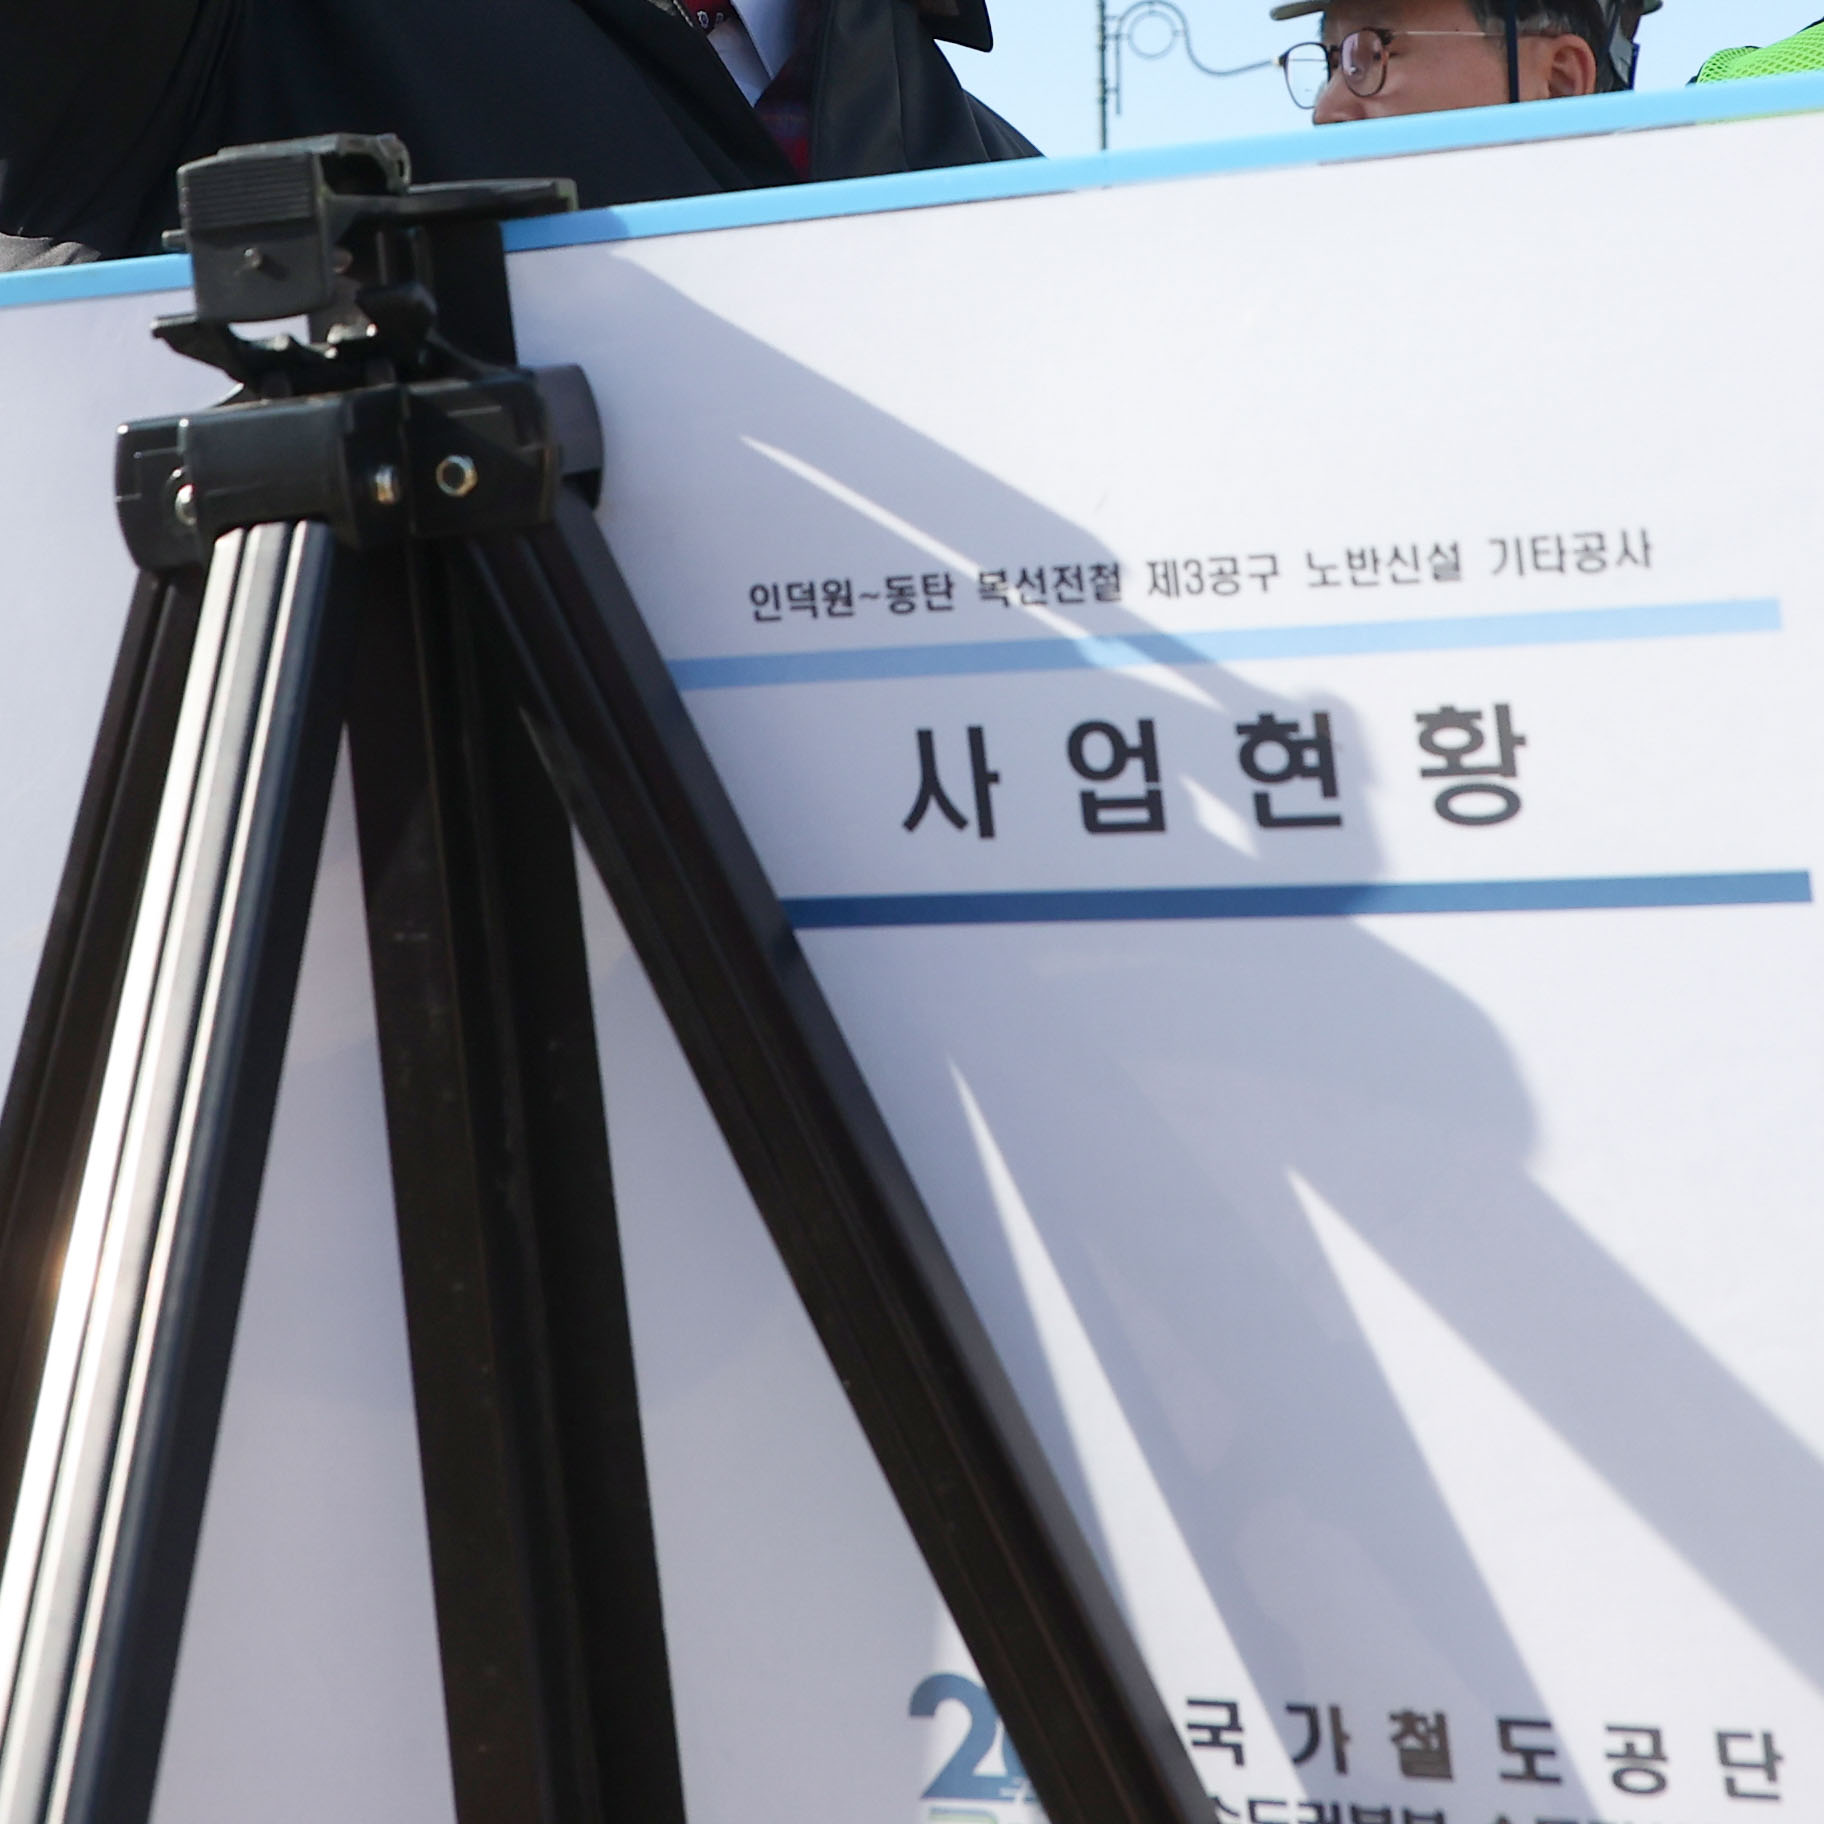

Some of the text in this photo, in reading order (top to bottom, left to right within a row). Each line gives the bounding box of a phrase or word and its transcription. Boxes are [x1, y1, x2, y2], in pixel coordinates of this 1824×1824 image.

[1146, 551, 1280, 599] 제3공구
[1304, 540, 1464, 589] 노반신설
[1488, 527, 1654, 576] 기타공사
